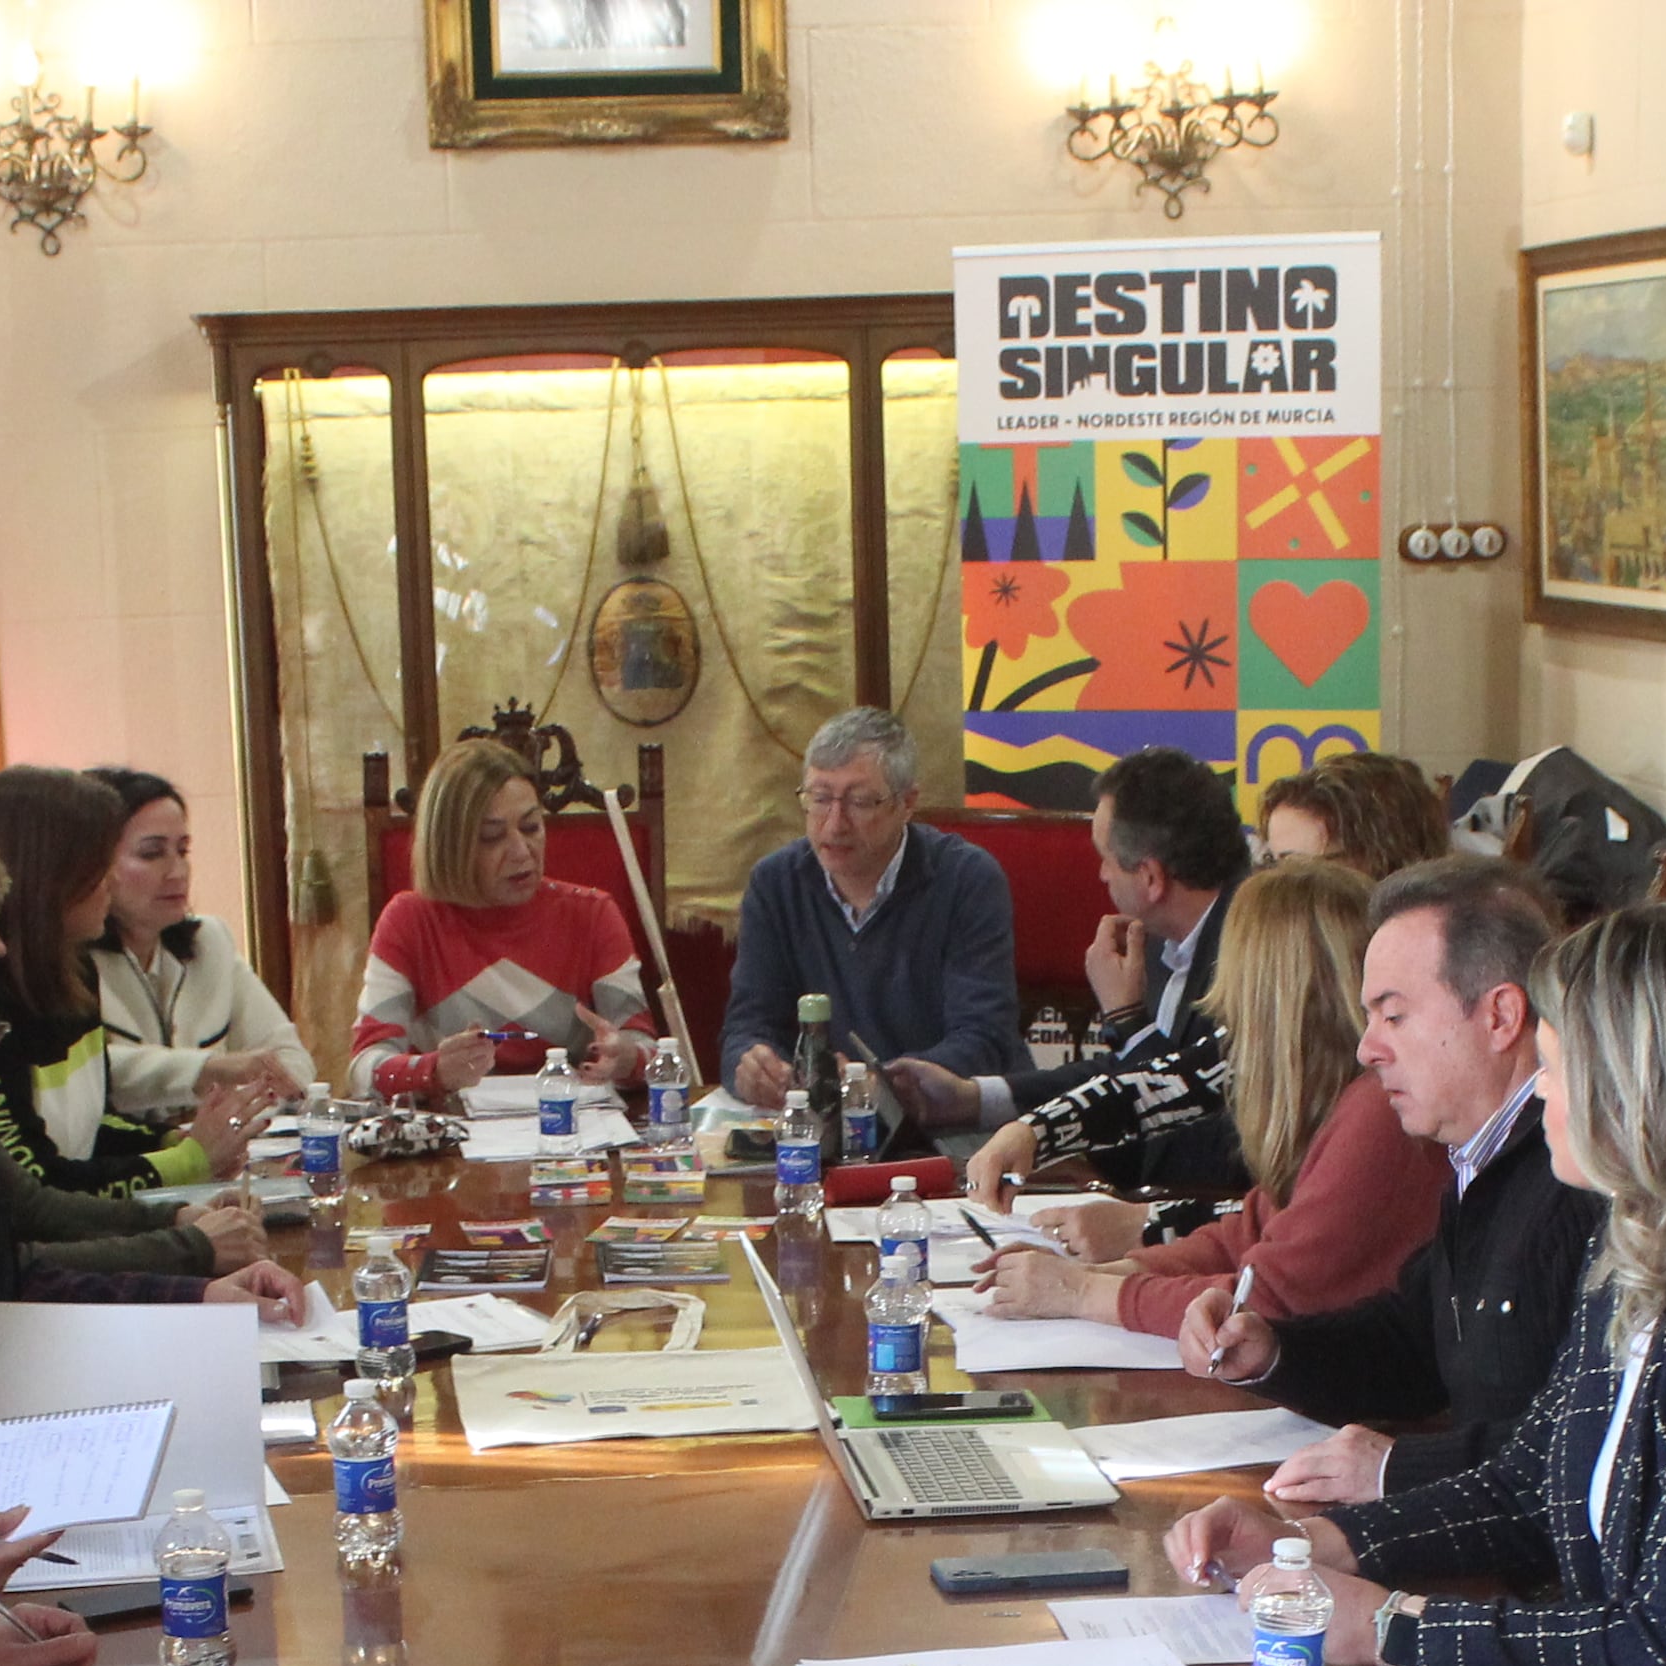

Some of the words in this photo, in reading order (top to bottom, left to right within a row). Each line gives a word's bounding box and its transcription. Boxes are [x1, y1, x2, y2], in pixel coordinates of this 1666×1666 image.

[999, 265, 1337, 339] DESTINO
[999, 338, 1336, 400] SINGULAR
[997, 414, 1059, 430] LEADER
[1078, 411, 1165, 428] NORDESTE
[1168, 404, 1233, 426] REGIÓN
[1240, 408, 1261, 424] DE
[1265, 407, 1336, 424] MURCIA
